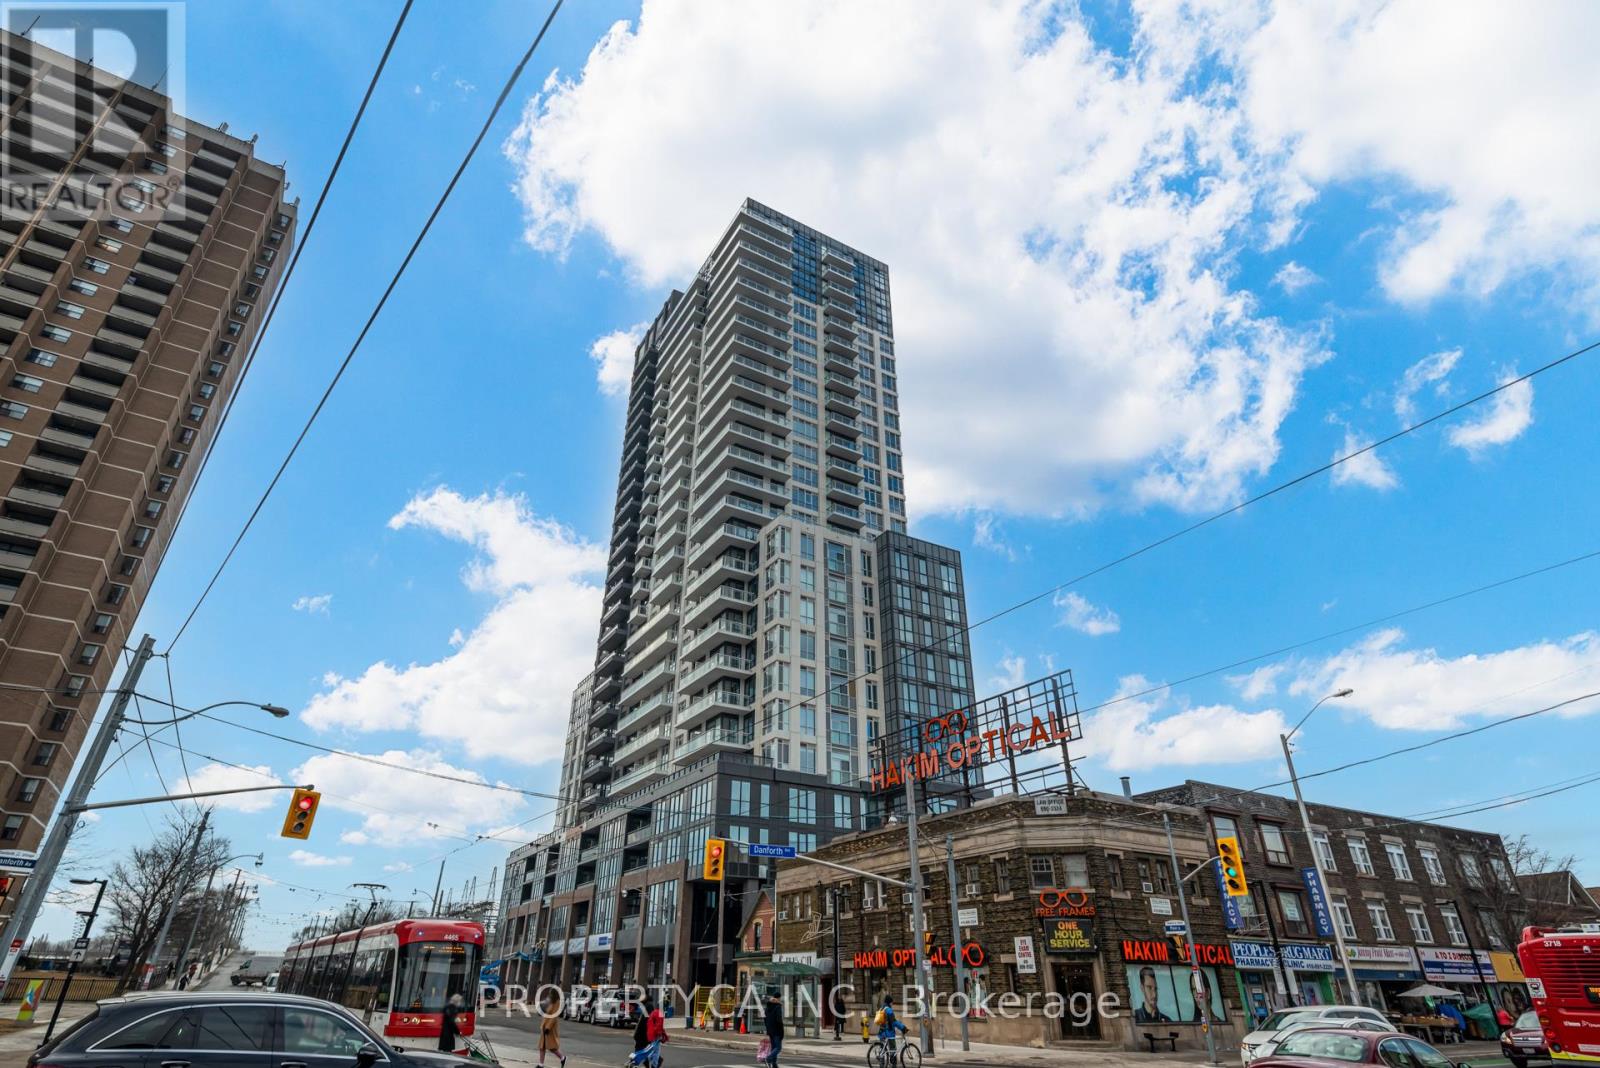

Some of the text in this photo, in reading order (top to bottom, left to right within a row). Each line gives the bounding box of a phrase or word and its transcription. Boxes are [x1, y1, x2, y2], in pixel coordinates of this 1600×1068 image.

[870, 711, 1072, 795] HAKIM OPTICAL
[753, 845, 784, 856] Danforth
[0, 857, 24, 867] anforth
[1306, 872, 1329, 933] PHARMACY
[1035, 905, 1096, 917] FREE FRAMES
[1057, 921, 1078, 930] ONE
[1054, 930, 1083, 939] HOUR
[1050, 938, 1091, 949] SERVICE
[1543, 940, 1562, 948] 3718
[853, 950, 888, 969] HAKIM
[892, 946, 948, 968] OPTAL
[1122, 940, 1235, 965] HAKIM PTICAL
[1233, 943, 1277, 957] PEOPLES
[1302, 947, 1331, 961] MART
[1235, 957, 1274, 968] PHARMACY
[1284, 960, 1306, 969] CLINIC
